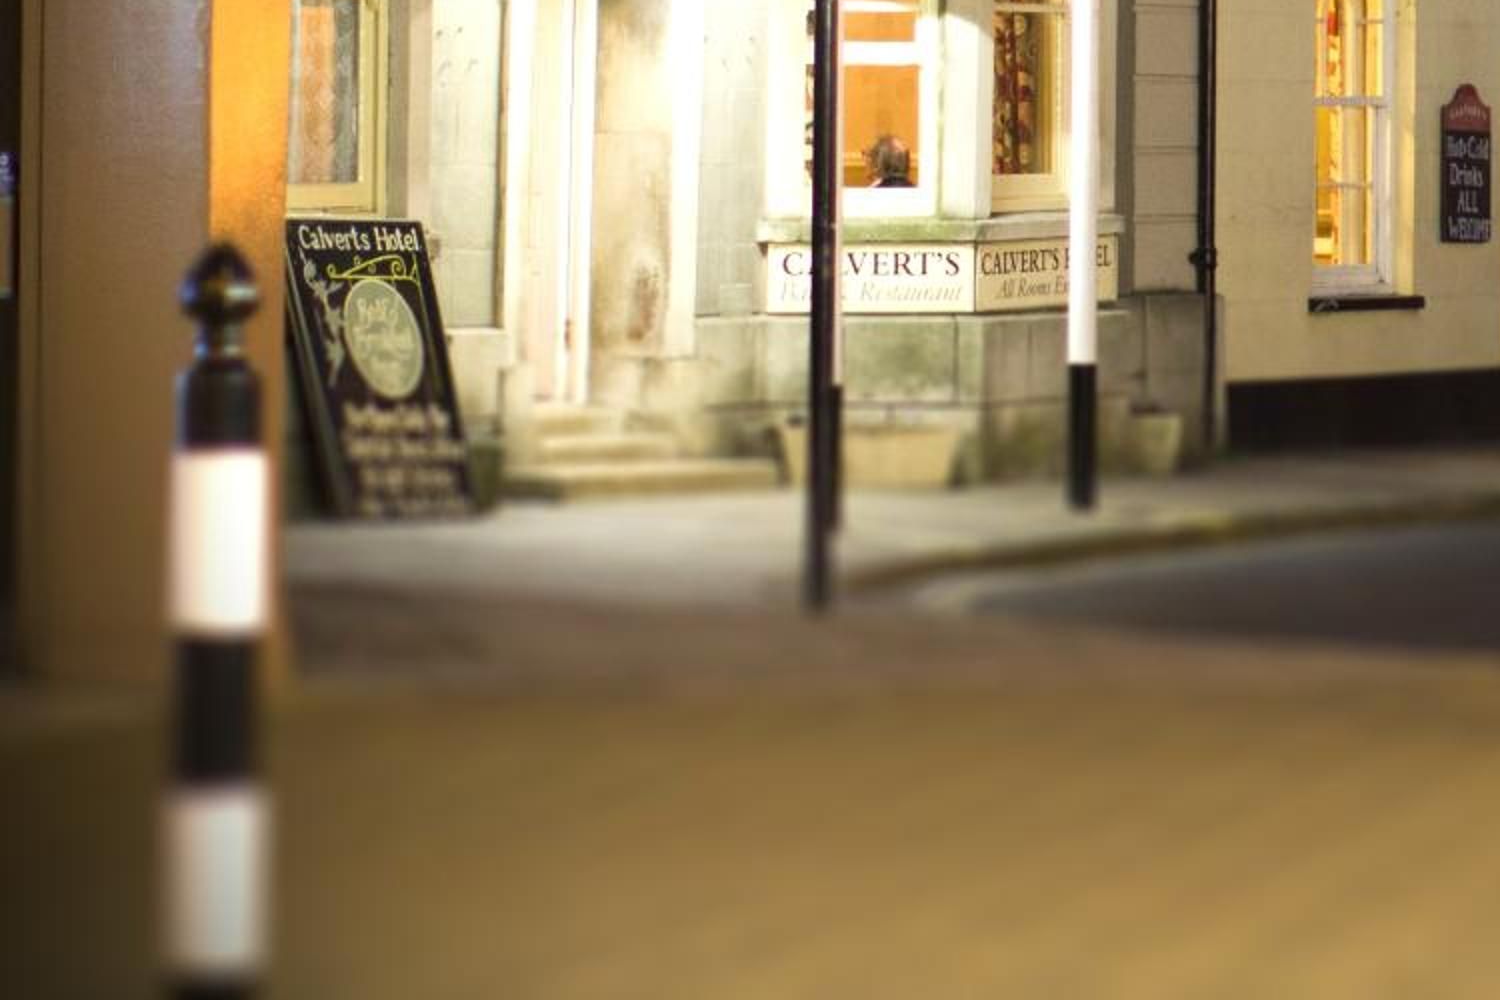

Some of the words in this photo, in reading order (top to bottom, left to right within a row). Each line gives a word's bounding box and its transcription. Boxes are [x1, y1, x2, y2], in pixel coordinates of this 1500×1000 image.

[298, 224, 371, 252] Calverts
[374, 226, 421, 252] Hotel
[782, 250, 961, 277] CVERT'S
[980, 247, 1060, 275] CALVERT'S
